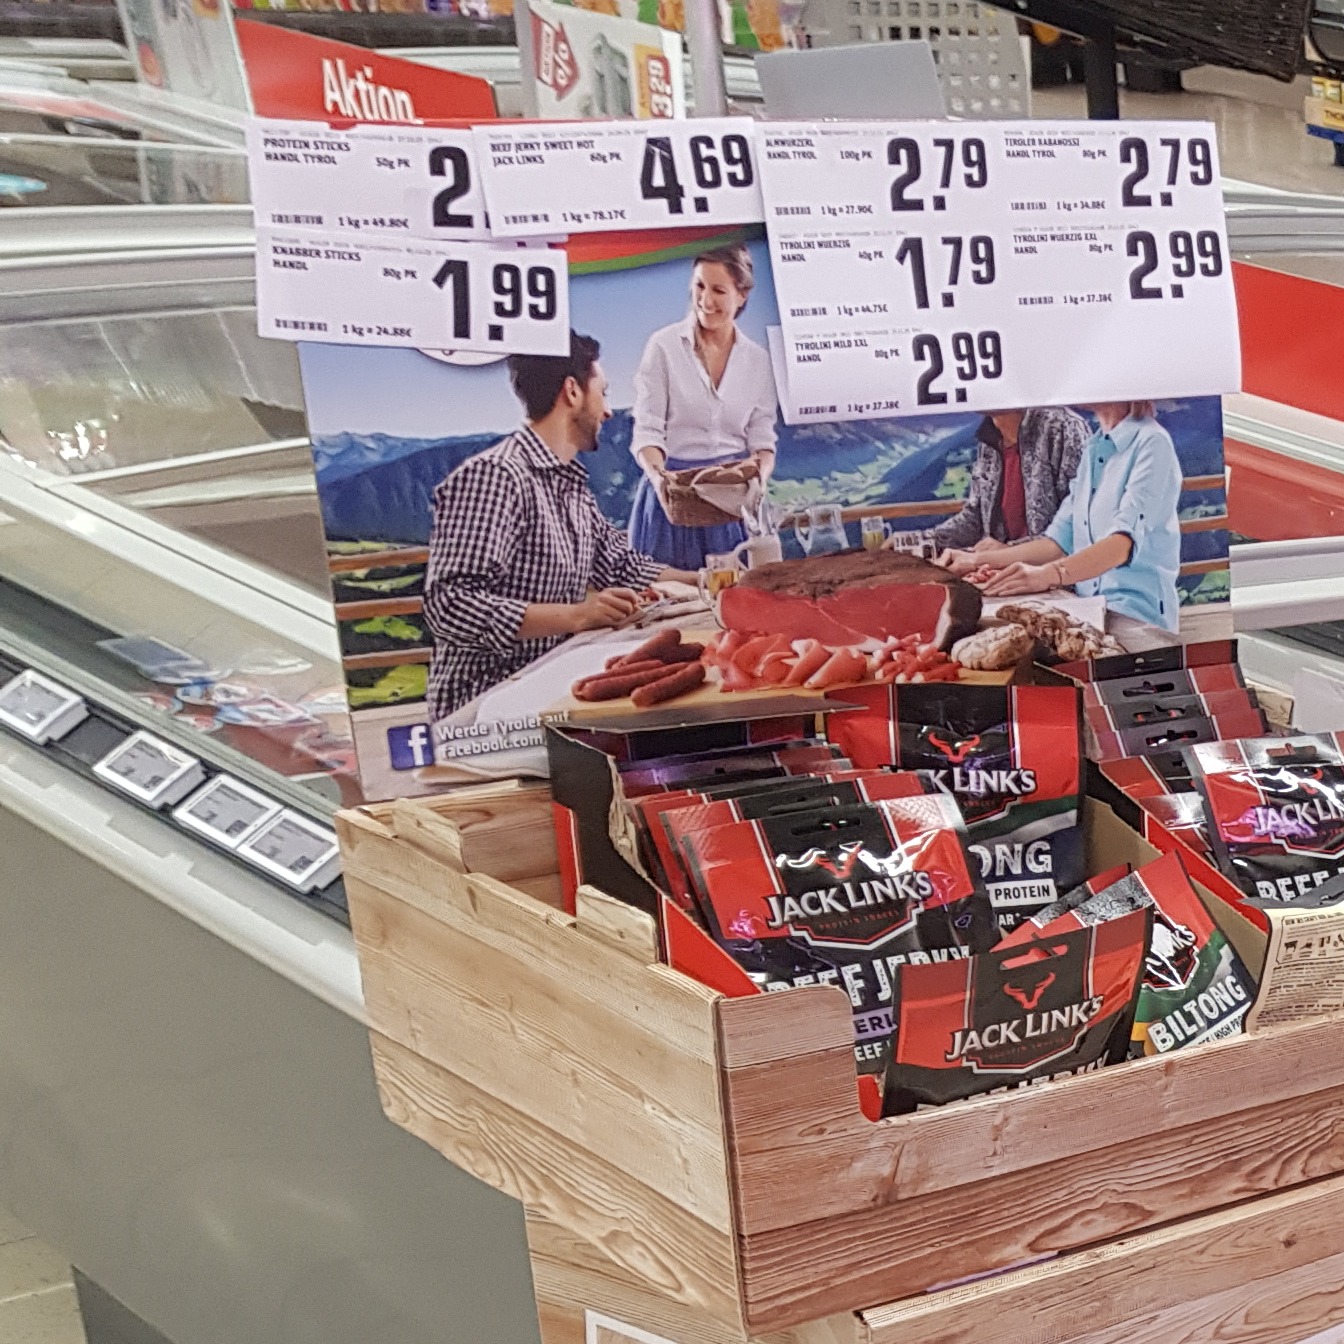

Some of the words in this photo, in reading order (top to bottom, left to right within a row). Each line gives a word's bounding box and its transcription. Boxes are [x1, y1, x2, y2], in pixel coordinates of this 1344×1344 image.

[321, 57, 414, 122] Aktion
[262, 137, 310, 150] PROTEIN
[312, 140, 350, 152] STICKS
[515, 140, 542, 154] JERKY
[544, 140, 574, 151] SWEET
[576, 138, 595, 150] HOT
[303, 153, 338, 166] TYROL
[609, 152, 622, 162] PK
[791, 150, 818, 160] TYROL
[840, 150, 861, 162] 100g
[862, 150, 873, 160] PK
[1032, 150, 1056, 159] TYROL
[1098, 150, 1108, 158] PK
[376, 156, 396, 170] 50g
[397, 158, 411, 169] PK
[492, 156, 515, 168] JACK
[516, 154, 546, 166] LINKS
[640, 134, 754, 214] 4.69
[886, 136, 988, 212] 2.79
[1119, 136, 1213, 208] 2.79
[828, 205, 838, 217] kg
[1062, 201, 1072, 212] kg
[348, 216, 360, 229] kg
[570, 212, 582, 224] kg
[1084, 232, 1098, 242] XXL
[272, 244, 322, 260] KNABBER
[324, 248, 362, 262] STICKS
[1103, 243, 1114, 252] PK
[873, 250, 884, 260] PK
[272, 258, 308, 271] HANDL
[1126, 230, 1224, 300] 2.99
[404, 269, 418, 280] PK
[894, 234, 996, 310] 1.79
[432, 258, 558, 342] 1.99
[1068, 294, 1078, 306] kg
[843, 304, 854, 317] kg
[351, 324, 365, 338] kg
[833, 339, 852, 350] MILD
[853, 338, 869, 348] XXL
[889, 348, 900, 358] PK
[911, 330, 1003, 406] 2.99
[853, 402, 864, 414] kg
[438, 722, 489, 741] Werde
[491, 716, 542, 737] Tyroler
[1254, 801, 1320, 833] JACK
[994, 884, 1050, 900] PROTEIN
[766, 888, 847, 929] JACK
[842, 869, 934, 908] LINK'S
[1147, 974, 1247, 1053] BILTONG
[945, 1018, 1022, 1062] JACK
